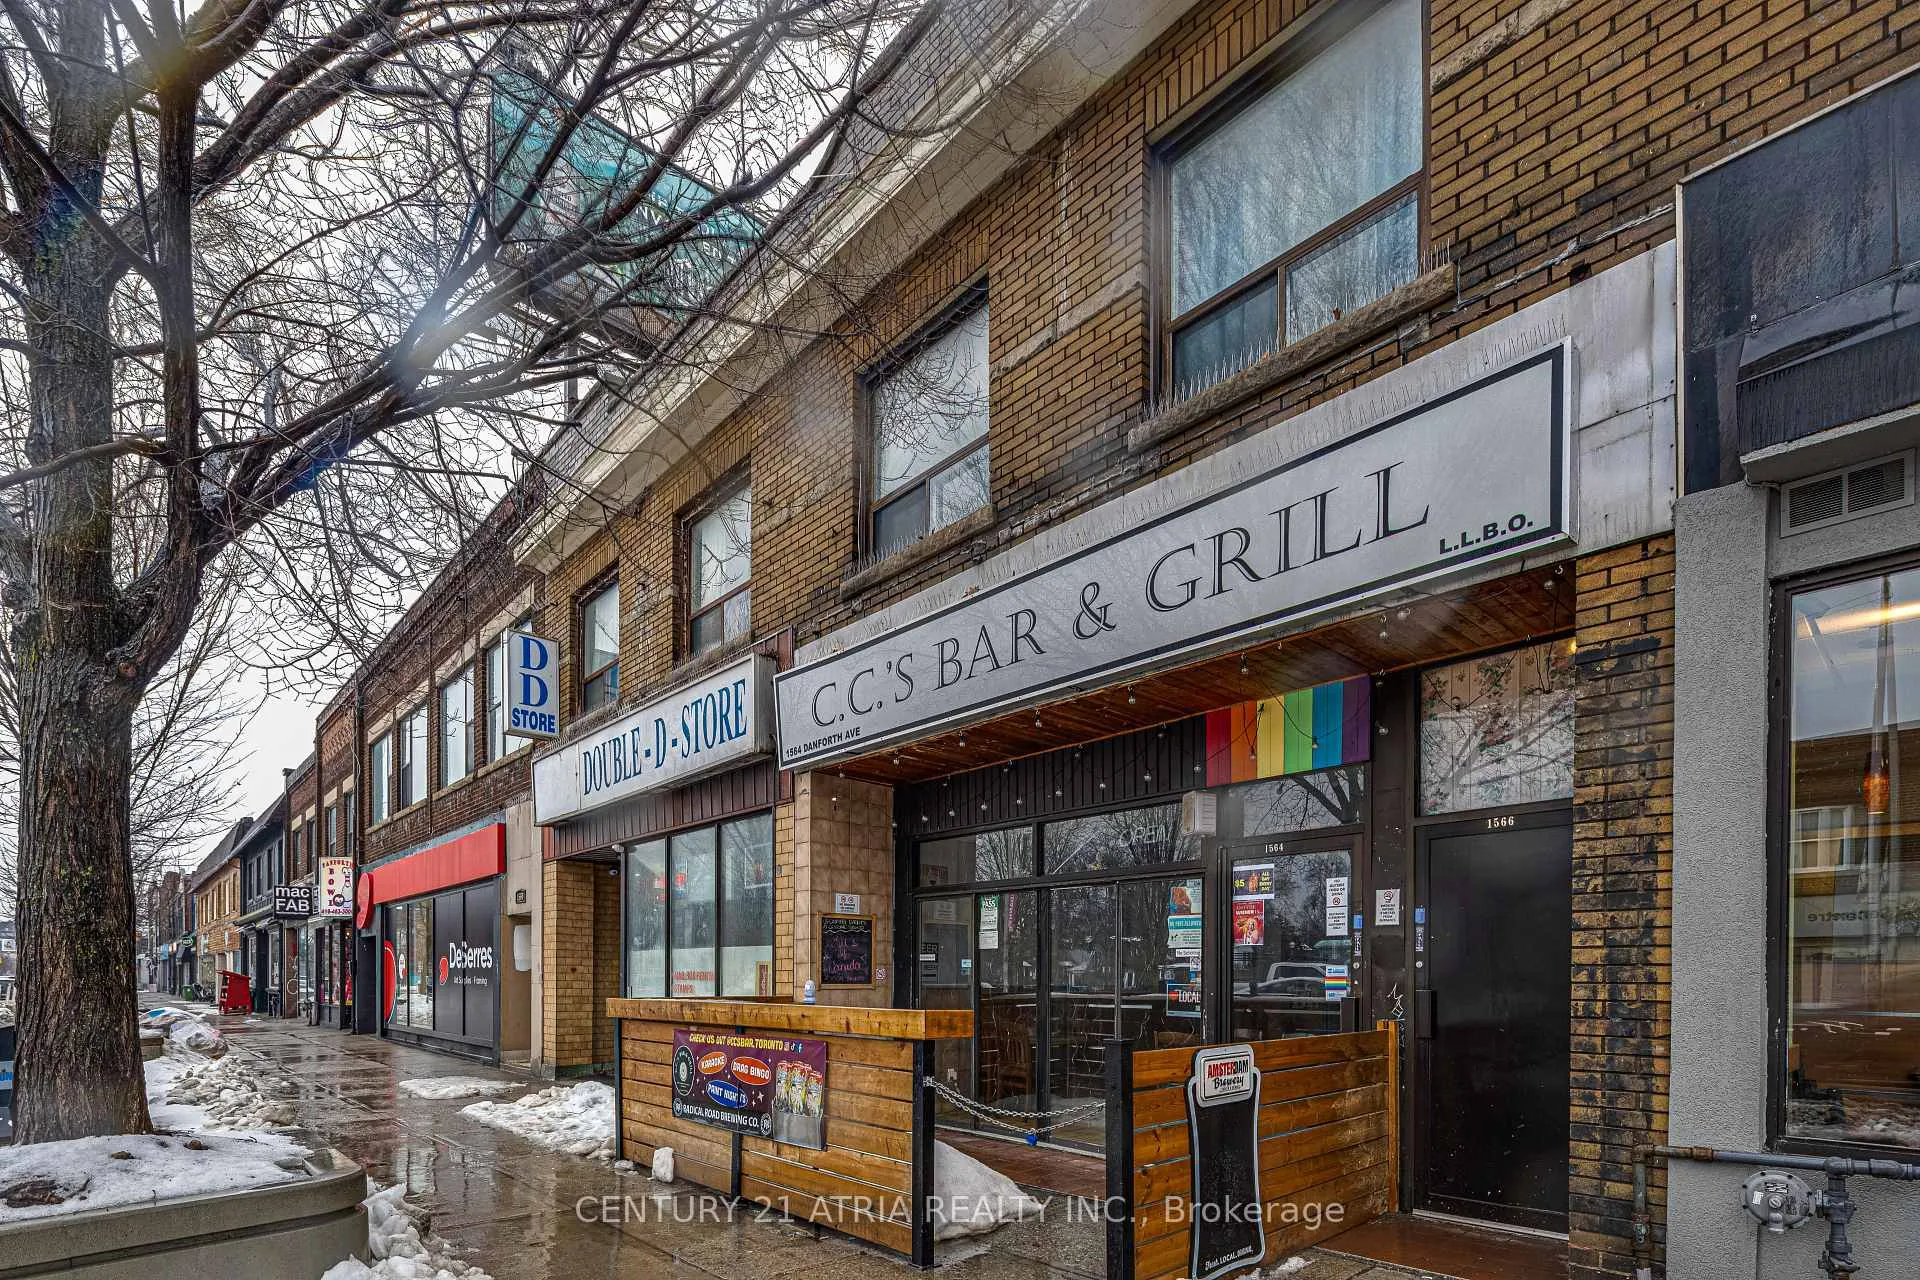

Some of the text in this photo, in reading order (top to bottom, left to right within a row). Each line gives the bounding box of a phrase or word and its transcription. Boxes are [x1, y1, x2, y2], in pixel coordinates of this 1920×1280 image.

[1438, 513, 1534, 557] L.L.B.O.
[811, 461, 1431, 728] C.C.'S BAR & GRILL
[519, 635, 549, 671] D
[519, 672, 549, 707] D
[511, 707, 556, 734] STORE
[786, 726, 861, 758] 1564 DANFORTH AVE
[1487, 815, 1515, 829] 1566
[1264, 842, 1284, 853] 1564
[275, 886, 310, 898] mac
[1234, 879, 1245, 888] $5
[275, 898, 310, 912] FAB
[449, 941, 493, 968] DeSerres
[689, 1033, 705, 1043] CHECK
[706, 1034, 715, 1044] US
[716, 1035, 726, 1045] OUT
[701, 1054, 725, 1069] KARAOKE
[732, 1061, 770, 1080] DRAG BINGO
[1207, 1060, 1249, 1078] AMSTERDAM
[708, 1083, 722, 1097] PAINT
[1214, 1076, 1245, 1089] Brewery
[682, 1105, 704, 1118] RADICAL
[705, 1108, 720, 1120] ROAD
[720, 1111, 748, 1126] BREWING
[748, 1116, 760, 1128] CO.
